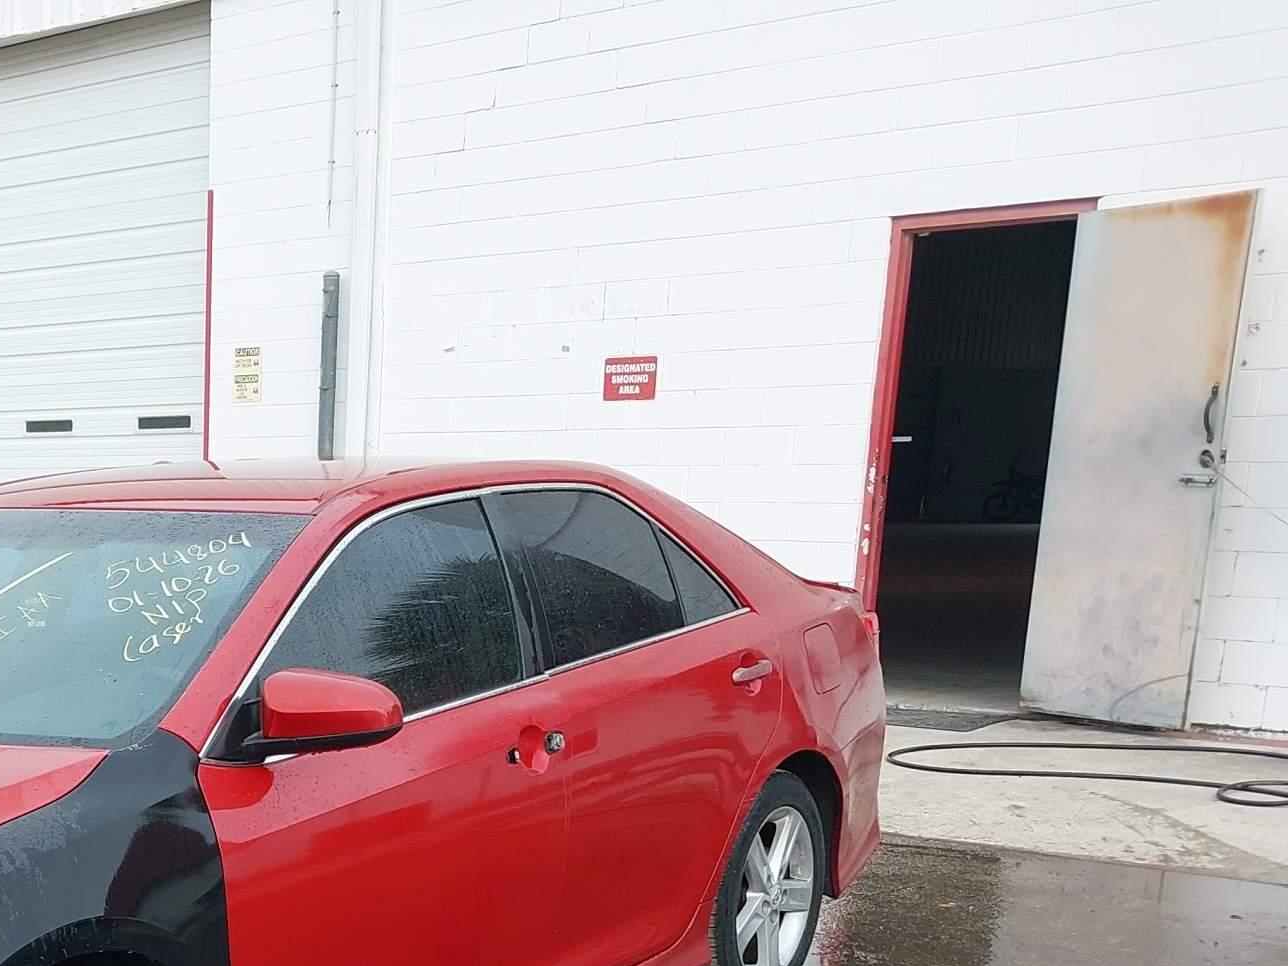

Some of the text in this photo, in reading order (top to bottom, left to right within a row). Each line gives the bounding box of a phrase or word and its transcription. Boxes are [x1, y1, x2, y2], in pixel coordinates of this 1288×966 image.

[606, 363, 656, 374] DESIGNATED
[611, 374, 649, 384] SMOKING
[618, 385, 640, 394] AREA
[106, 532, 252, 589] 544804
[141, 588, 207, 625] NIP
